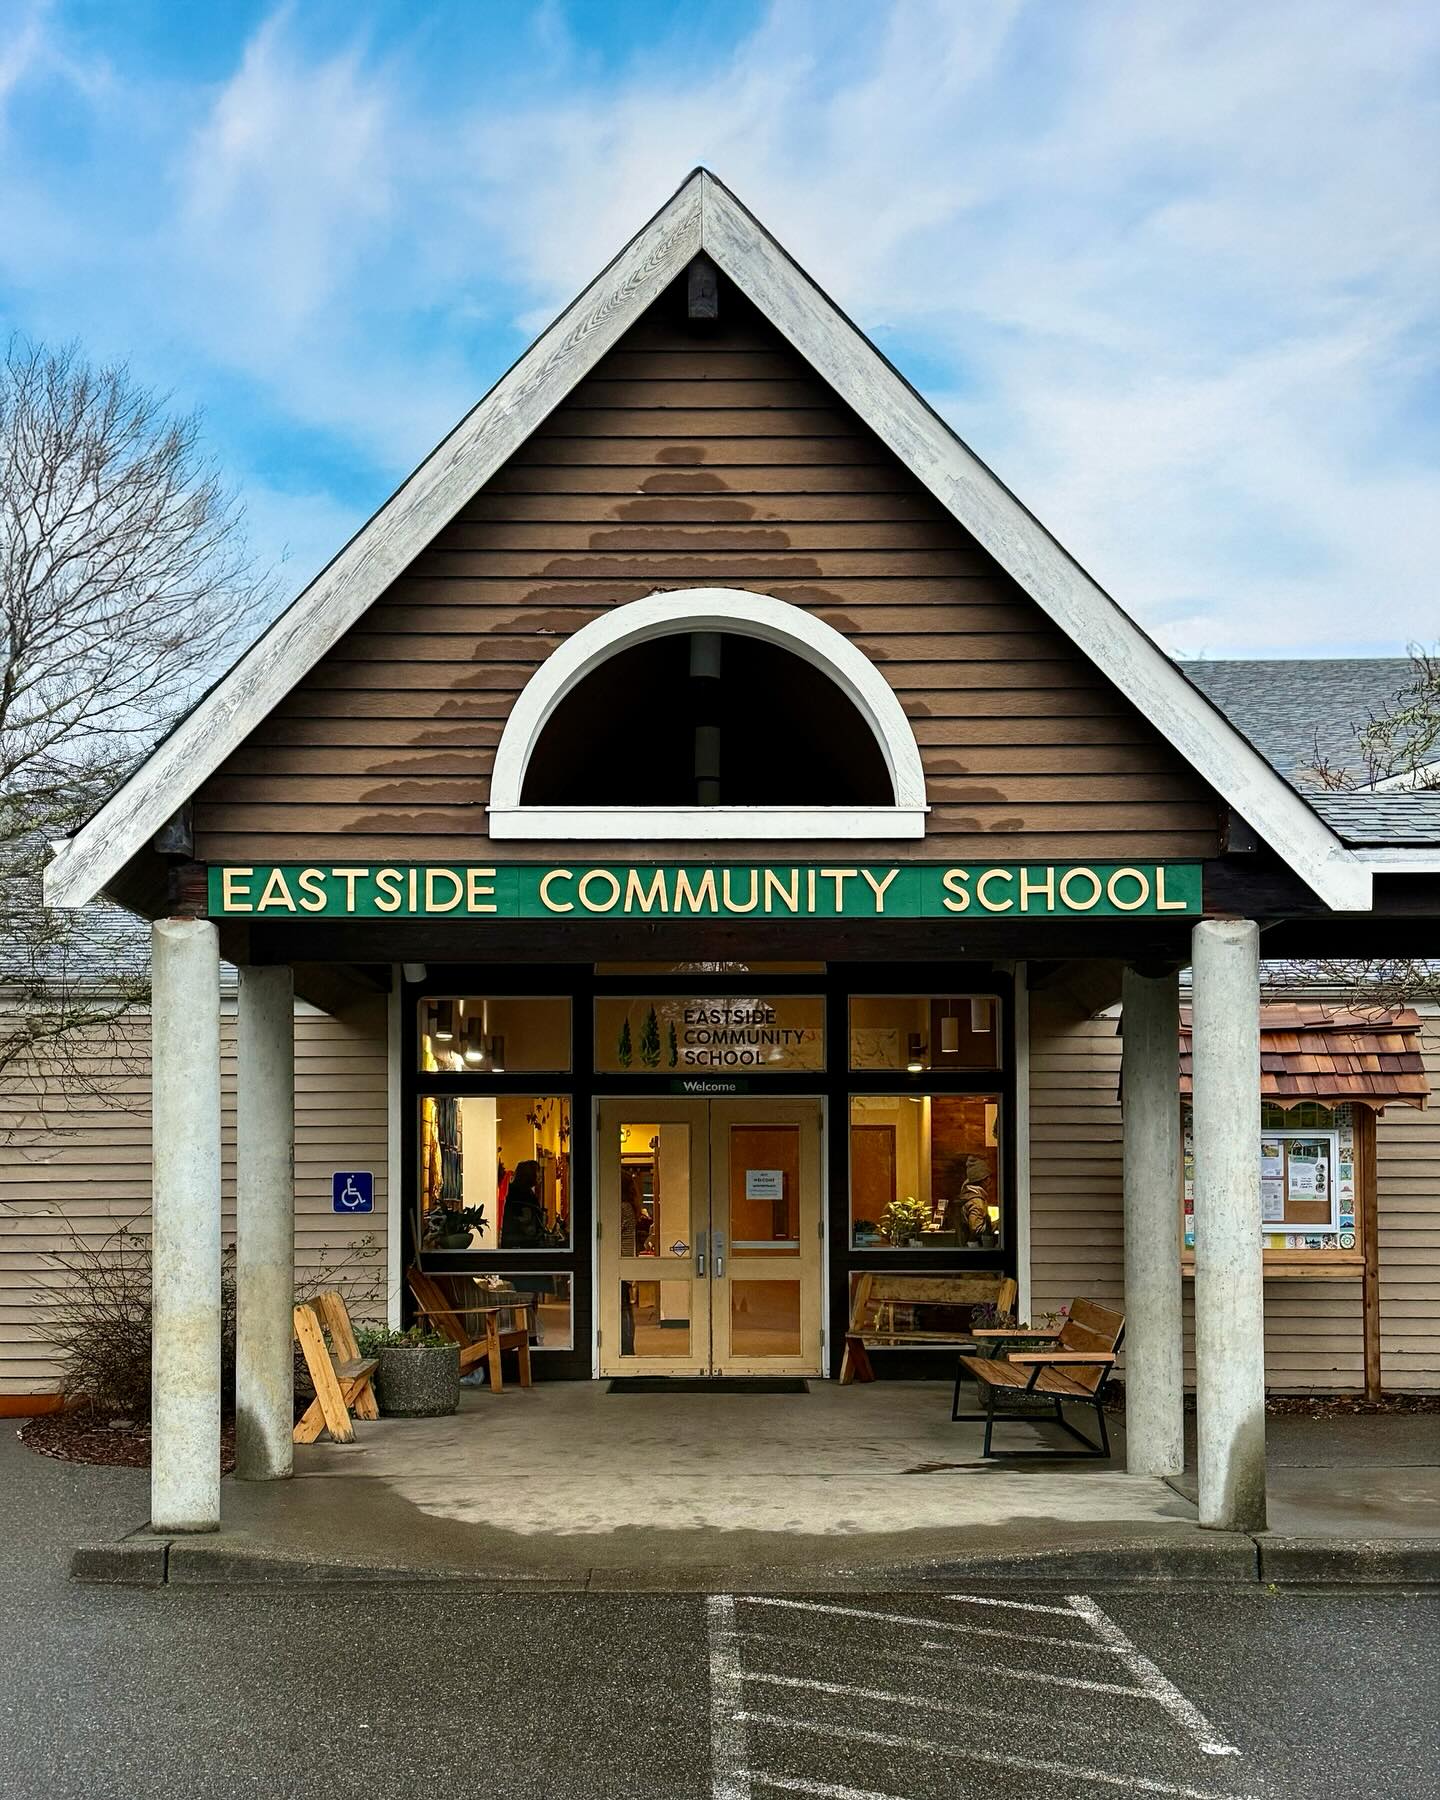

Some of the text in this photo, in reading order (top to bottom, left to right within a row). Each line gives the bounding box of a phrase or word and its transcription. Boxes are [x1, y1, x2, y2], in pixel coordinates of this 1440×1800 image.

[222, 867, 1187, 914] EASTSIDE COMMUNITY SCHOOL
[684, 1009, 776, 1024] EASTSIDE
[684, 1029, 804, 1045] COMMUNITY
[685, 1050, 765, 1065] SCHOOL
[683, 1081, 736, 1092] Welcome
